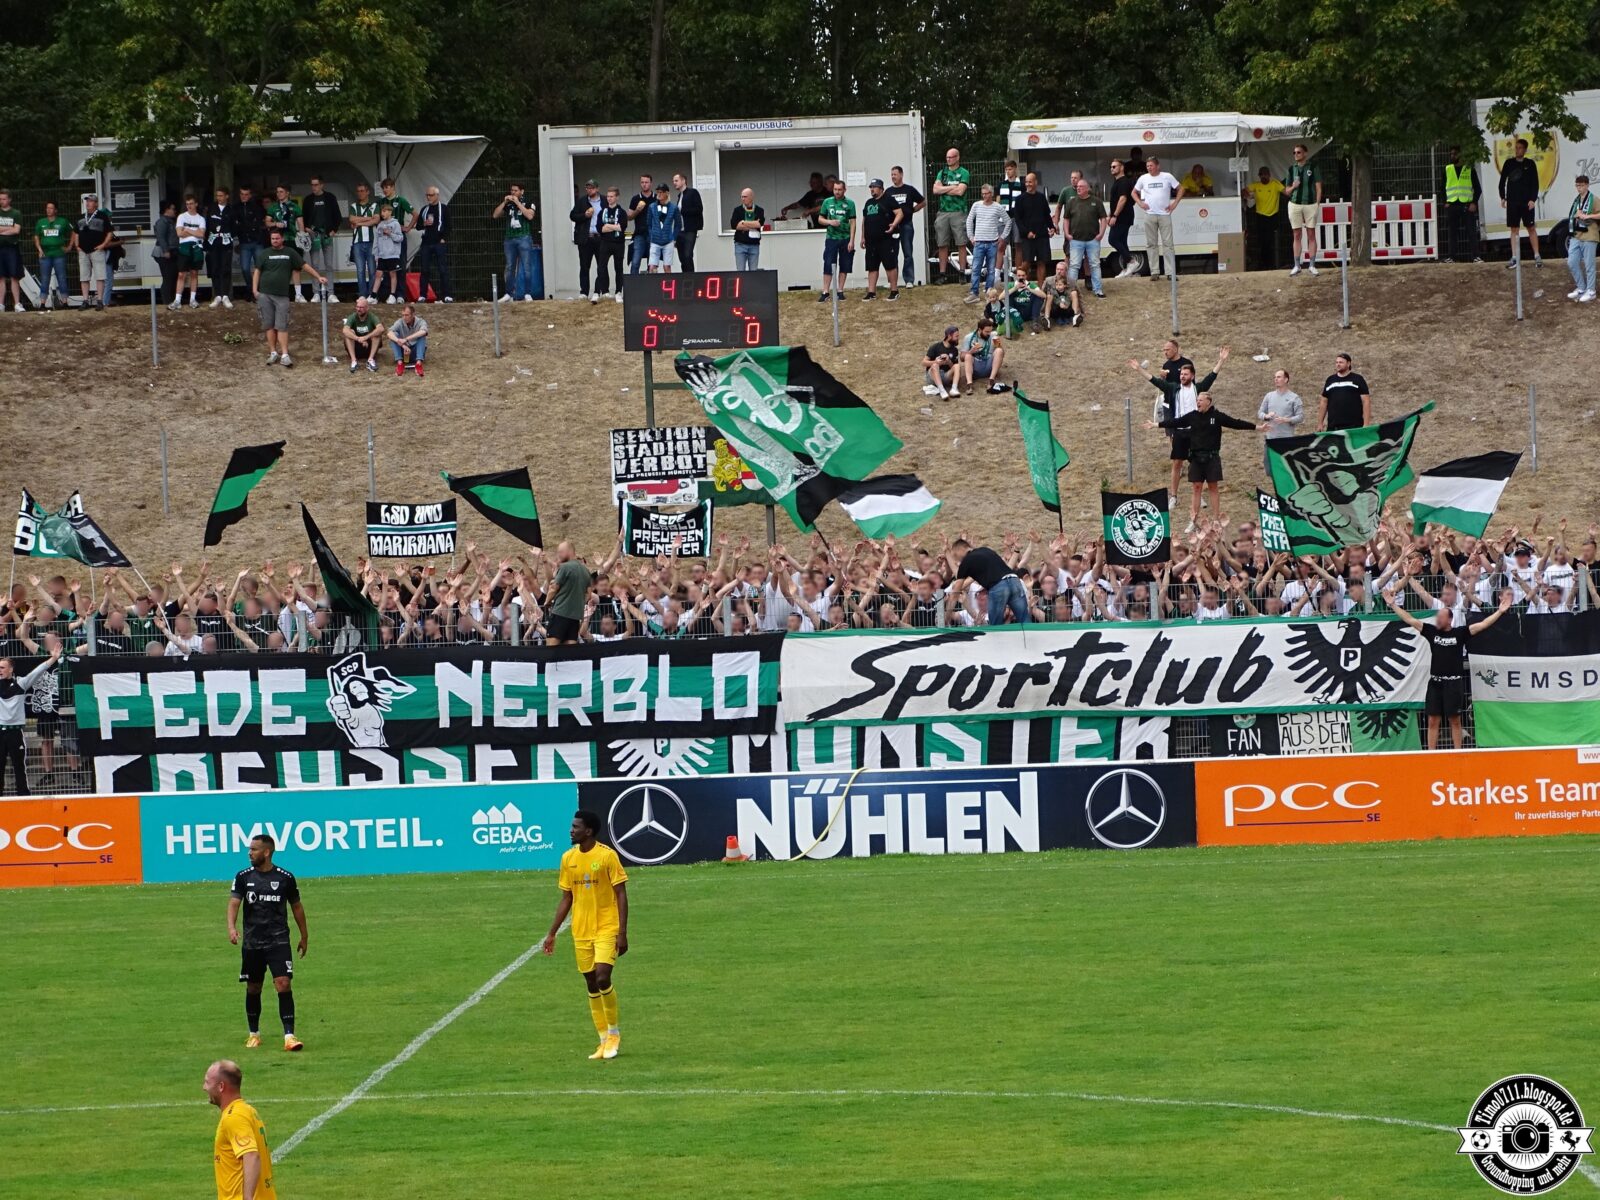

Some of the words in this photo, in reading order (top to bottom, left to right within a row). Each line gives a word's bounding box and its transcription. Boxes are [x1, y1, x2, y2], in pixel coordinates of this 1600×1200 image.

[672, 124, 705, 133] LICHTE
[707, 123, 748, 131] CONTAINER
[749, 121, 793, 130] DUISBURG
[613, 426, 706, 444] SEKTION
[614, 439, 707, 459] STADION
[1307, 445, 1341, 464] SCP
[614, 453, 707, 475] VERBOT
[380, 504, 410, 525] LSD
[414, 503, 443, 524] UND
[649, 513, 687, 525] FEDE
[1115, 502, 1133, 520] FEDE
[369, 532, 455, 556] MARIHUANA
[632, 529, 704, 543] PREUSSEN
[340, 661, 359, 677] SCP
[806, 627, 1274, 722] Sportclub
[92, 668, 307, 740] FEDE
[434, 651, 761, 728] NERBLO
[1227, 728, 1262, 750] FAN
[1281, 724, 1315, 747] AUS
[1318, 722, 1352, 744] DEM
[1431, 779, 1529, 806] Starkes
[1535, 777, 1600, 803] Team
[737, 771, 1040, 861] NÜHLEN
[1366, 813, 1381, 822] SE
[1514, 811, 1526, 820] Ihr
[1528, 809, 1580, 821] zuverlässiger
[166, 817, 444, 855] HEIMVORTEIL.
[472, 825, 543, 845] GEBAG
[100, 854, 113, 864] SE
